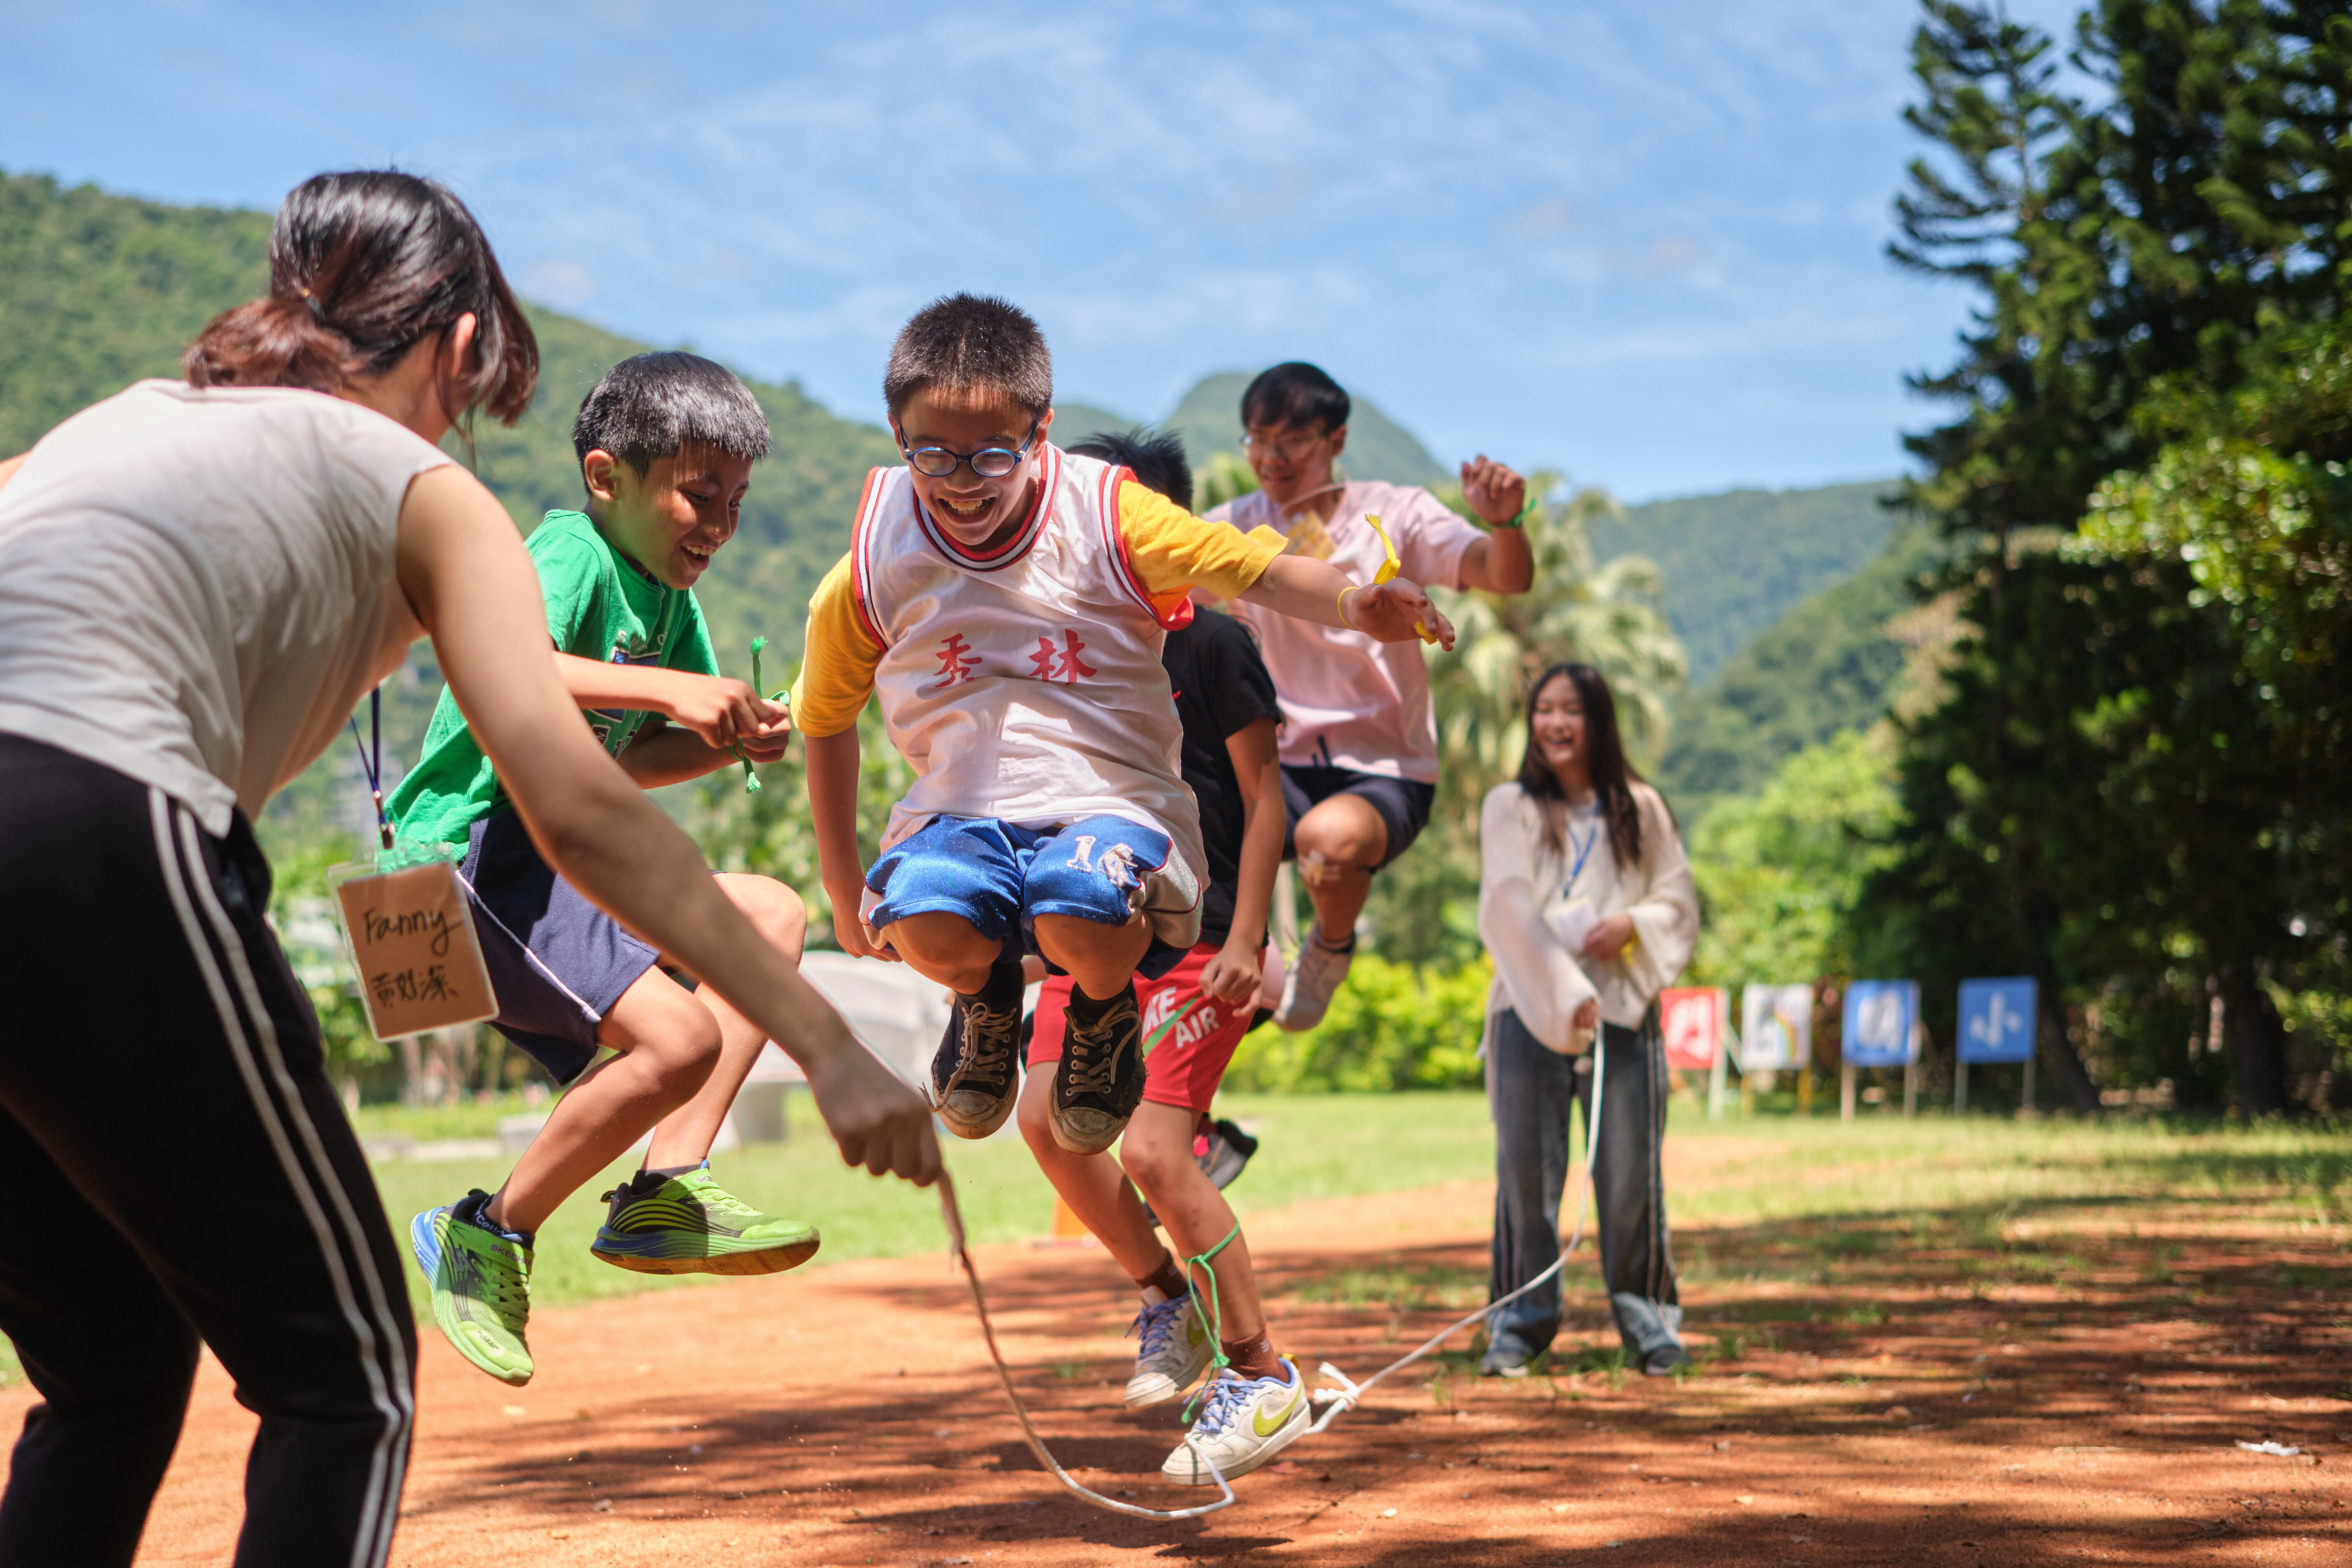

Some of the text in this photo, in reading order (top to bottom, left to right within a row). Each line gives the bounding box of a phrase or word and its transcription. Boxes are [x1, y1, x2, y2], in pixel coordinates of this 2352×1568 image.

[933, 629, 1097, 687] 秀林
[363, 908, 464, 957] Fanny
[1175, 1006, 1219, 1049] AIR
